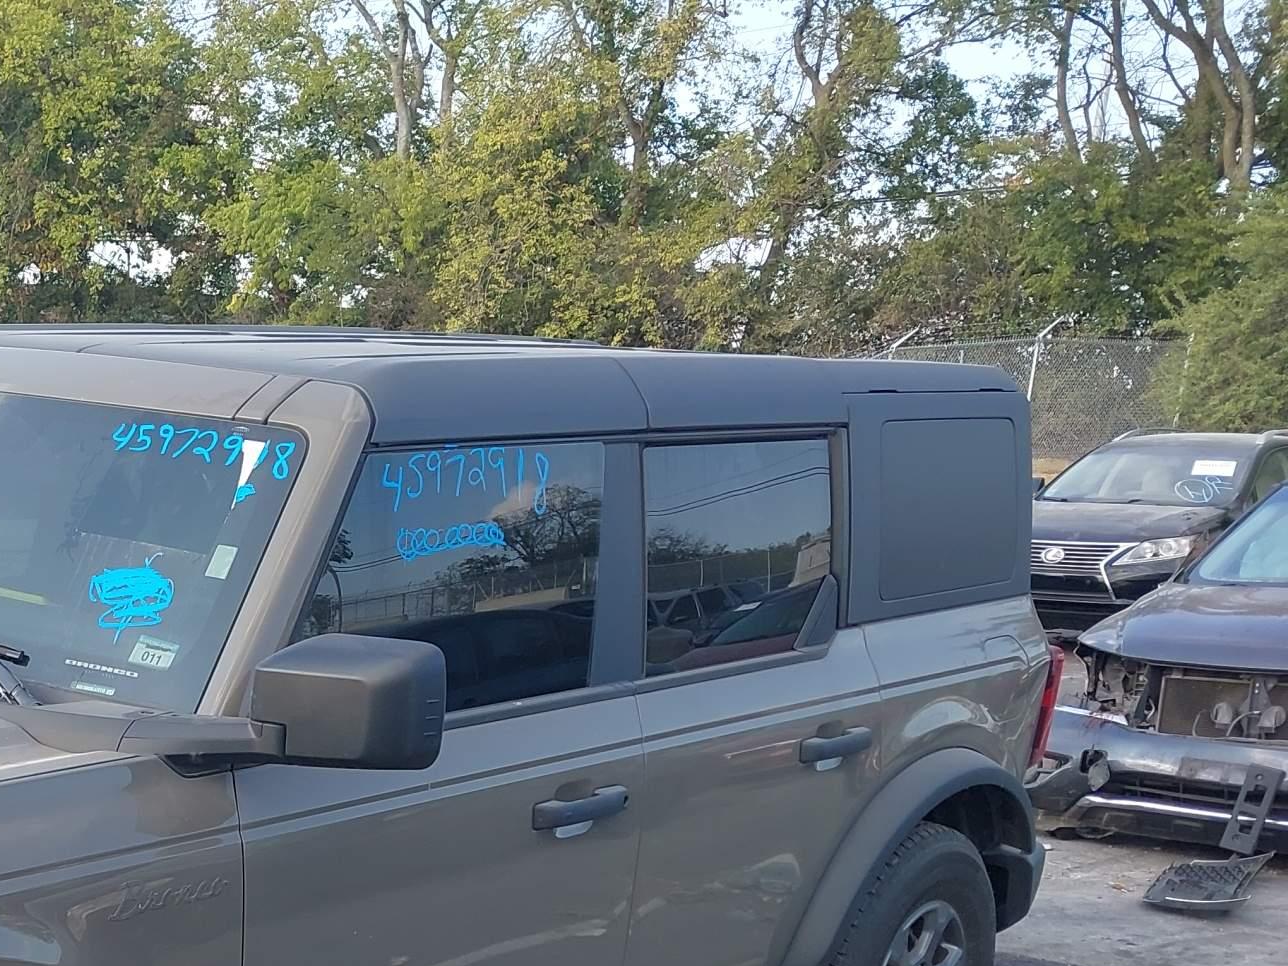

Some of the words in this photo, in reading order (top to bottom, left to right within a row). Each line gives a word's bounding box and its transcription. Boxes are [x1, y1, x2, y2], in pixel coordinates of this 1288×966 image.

[112, 423, 296, 479] 45972918
[381, 447, 550, 515] 45972918
[65, 659, 139, 678] BRONCO
